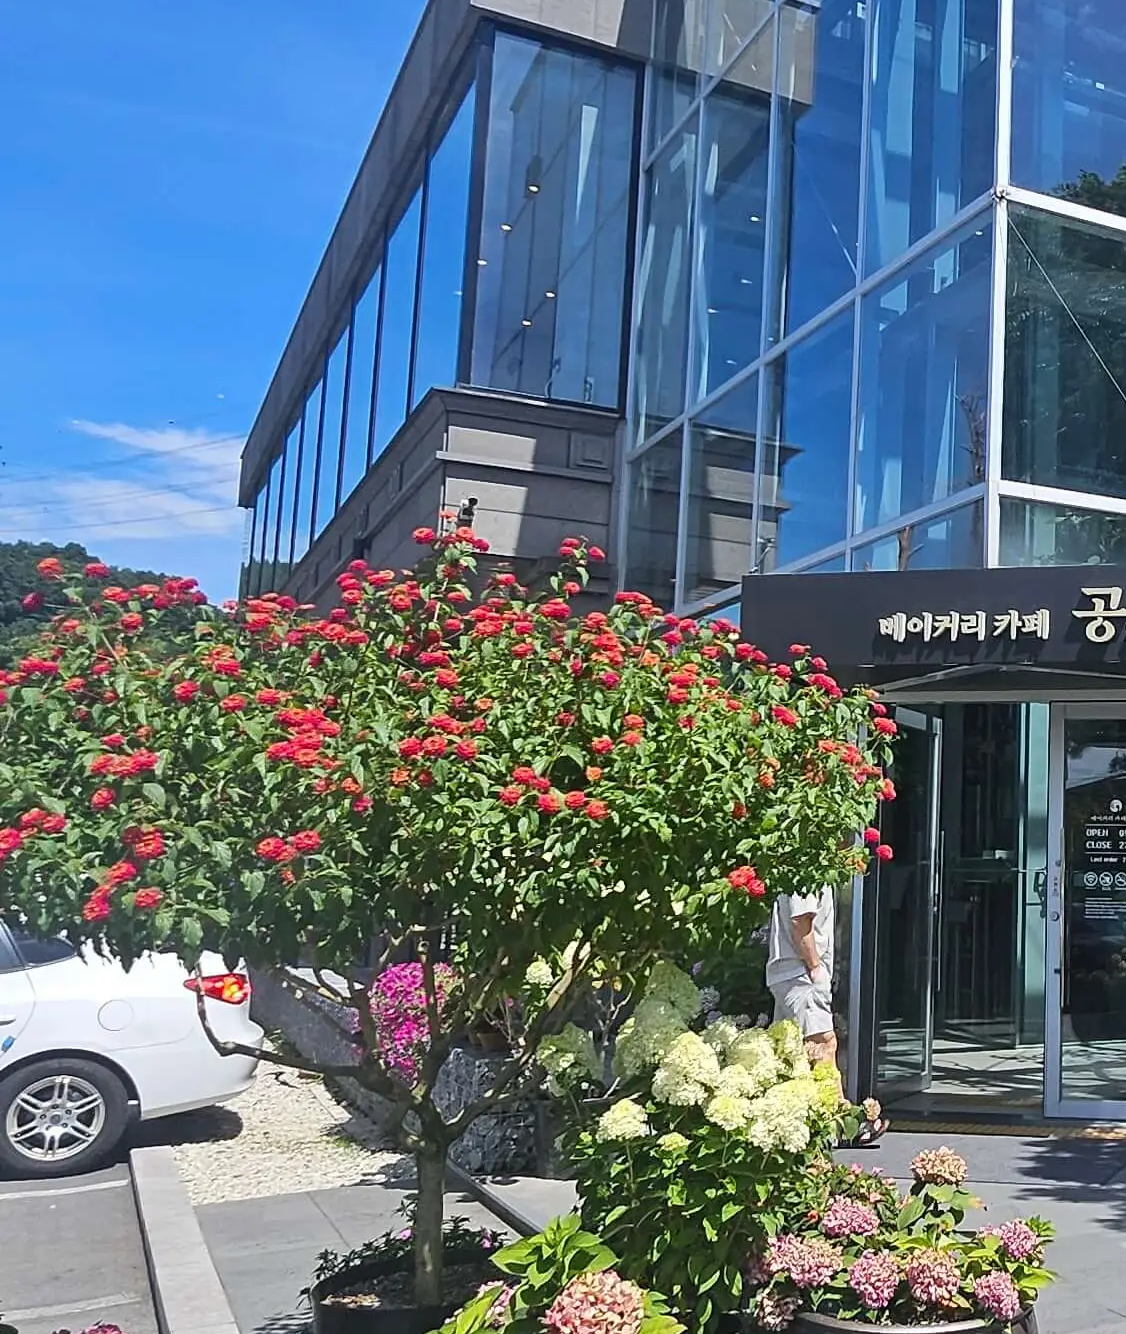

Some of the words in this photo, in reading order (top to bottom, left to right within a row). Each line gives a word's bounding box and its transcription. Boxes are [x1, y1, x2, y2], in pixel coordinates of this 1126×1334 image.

[879, 611, 986, 642] 베이커리
[992, 609, 1050, 641] 카페
[1086, 828, 1109, 837] OPEN
[1086, 840, 1112, 849] CLOSE
